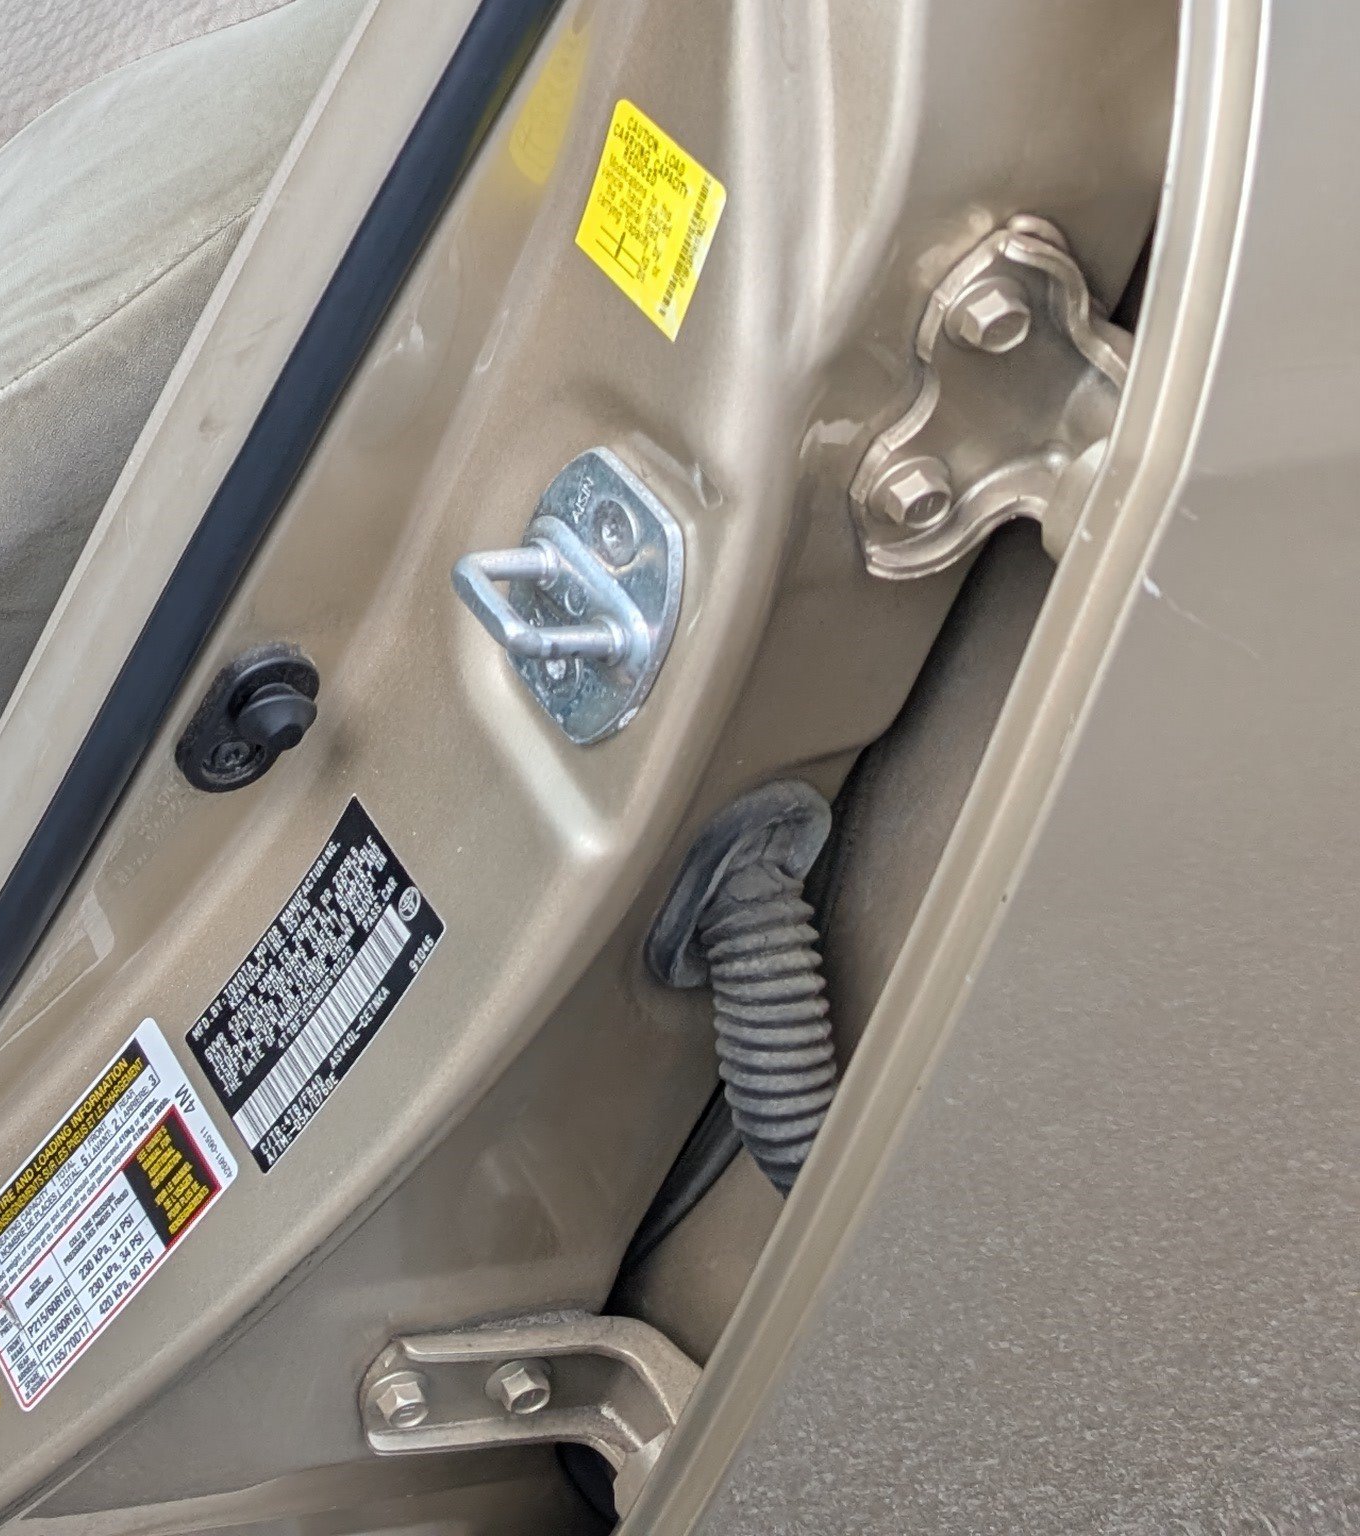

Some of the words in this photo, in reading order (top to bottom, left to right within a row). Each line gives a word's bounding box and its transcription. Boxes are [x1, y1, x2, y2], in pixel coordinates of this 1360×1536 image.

[203, 1030, 227, 1062] GVWR
[277, 944, 292, 966] FR
[319, 886, 333, 907] RR
[209, 1038, 231, 1070] THIS
[230, 993, 266, 1041] VEHICLE
[265, 942, 306, 997] CONFORMS
[305, 925, 318, 944] TO
[219, 1052, 246, 1087] THEFT
[246, 989, 295, 1054] PREVENTION
[294, 930, 337, 992] STANDARDS
[374, 852, 388, 872] ON
[253, 923, 281, 962] MOTOR
[407, 933, 435, 974] 91046
[213, 1033, 248, 1079] FEDERAL
[249, 998, 277, 1035] MOTOR
[276, 952, 311, 1000] VEHICLE
[223, 1073, 242, 1099] THE
[241, 1044, 265, 1077] DATE
[264, 1028, 278, 1048] OF
[276, 959, 329, 1032] MANUFACTURE
[328, 922, 355, 961] SHOWN
[12, 1165, 35, 1194] AND
[32, 1122, 72, 1172] LOADING
[69, 1056, 128, 1129] INFORMATION
[19, 1186, 49, 1224] CAPACITY
[55, 1156, 75, 1183] TOTAL
[85, 1119, 108, 1147] FRONT
[117, 1087, 136, 1111] REAR
[41, 1158, 57, 1180] SUR
[53, 1144, 69, 1166] LES
[65, 1121, 89, 1152] PNEUS
[84, 1112, 96, 1129] ET
[93, 1103, 105, 1120] LE
[101, 1056, 144, 1111] CHARGEMENT
[173, 1081, 198, 1118] 4M
[0, 1225, 26, 1259] NOMBRE
[24, 1215, 35, 1231] DE
[32, 1190, 58, 1222] PLACES
[79, 1152, 89, 1167] 5
[110, 1116, 120, 1132] 2
[147, 1072, 157, 1087] 3
[26, 1284, 72, 1338] P215/60R16
[77, 1257, 95, 1281] 230
[91, 1238, 112, 1266] kPa,
[108, 1227, 122, 1246] 34
[118, 1212, 135, 1234] PSI
[35, 1302, 81, 1356] P215/60R16
[87, 1275, 105, 1299] 230
[101, 1256, 122, 1284] kPa,
[118, 1244, 132, 1263] 34
[128, 1229, 144, 1252] PSI
[96, 1293, 114, 1317] 420
[111, 1273, 132, 1302] kPa,
[127, 1262, 141, 1281] 60
[138, 1247, 154, 1269] PSI
